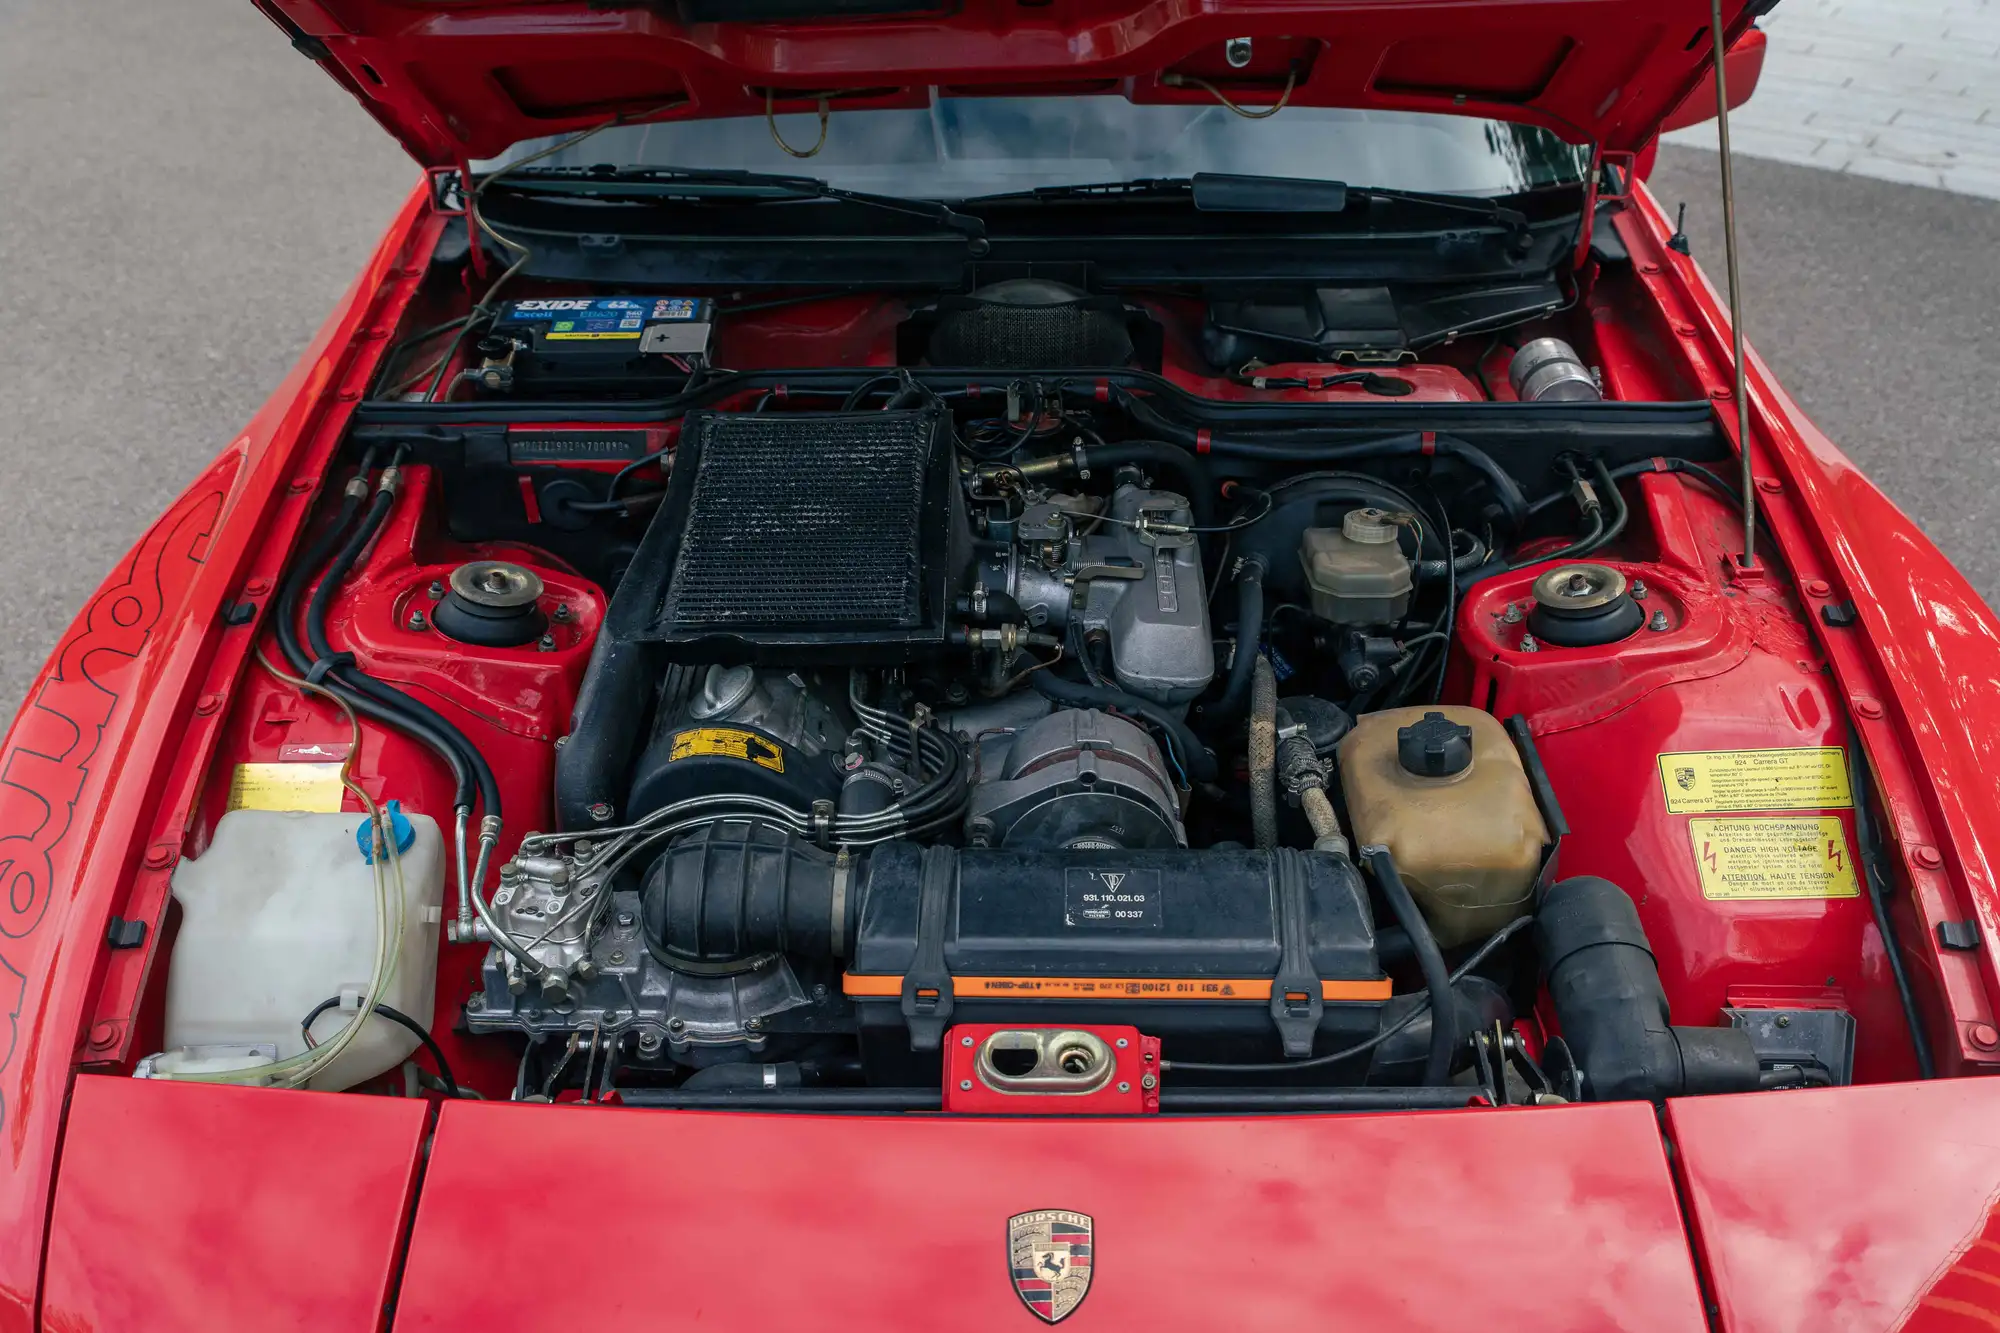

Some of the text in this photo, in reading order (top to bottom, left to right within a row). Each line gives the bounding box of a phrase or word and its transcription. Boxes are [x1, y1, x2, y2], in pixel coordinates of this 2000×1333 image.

[515, 300, 592, 310] EXIDE
[1682, 796, 1704, 804] Carrera
[1713, 823, 1819, 832] ACHTUNG HOCHSPANNUNG
[1723, 846, 1757, 854] DANGER
[1782, 845, 1819, 853] VOLTAGE
[1769, 872, 1797, 880] HAUTE
[1142, 983, 1171, 992] 12100
[1176, 983, 1195, 992] 110
[1201, 983, 1219, 992] 931
[1013, 1212, 1089, 1227] PORSCHE
